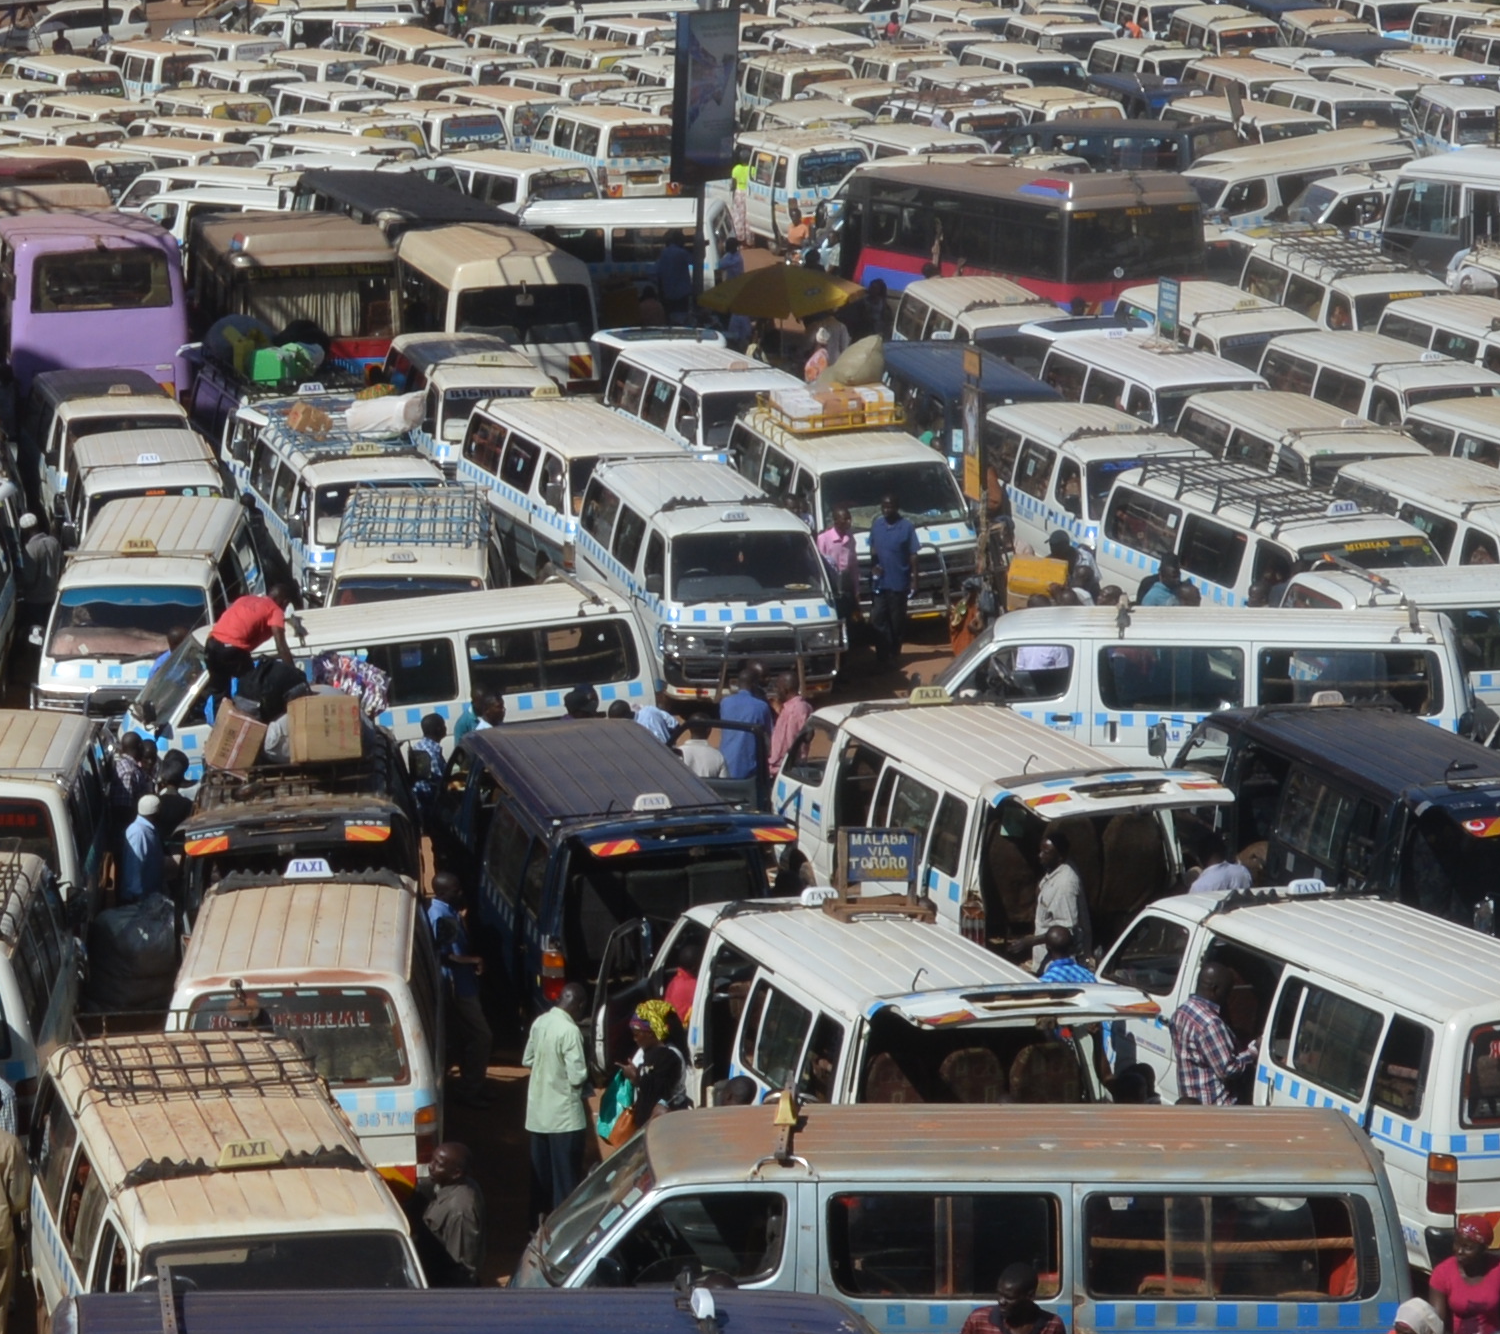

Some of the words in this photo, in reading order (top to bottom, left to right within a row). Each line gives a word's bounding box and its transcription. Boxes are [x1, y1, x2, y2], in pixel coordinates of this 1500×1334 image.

[443, 132, 500, 144] MANDO
[849, 831, 908, 847] MALABA
[868, 844, 891, 857] VIA
[848, 854, 908, 871] TORORO
[227, 1142, 267, 1160] TAXI
